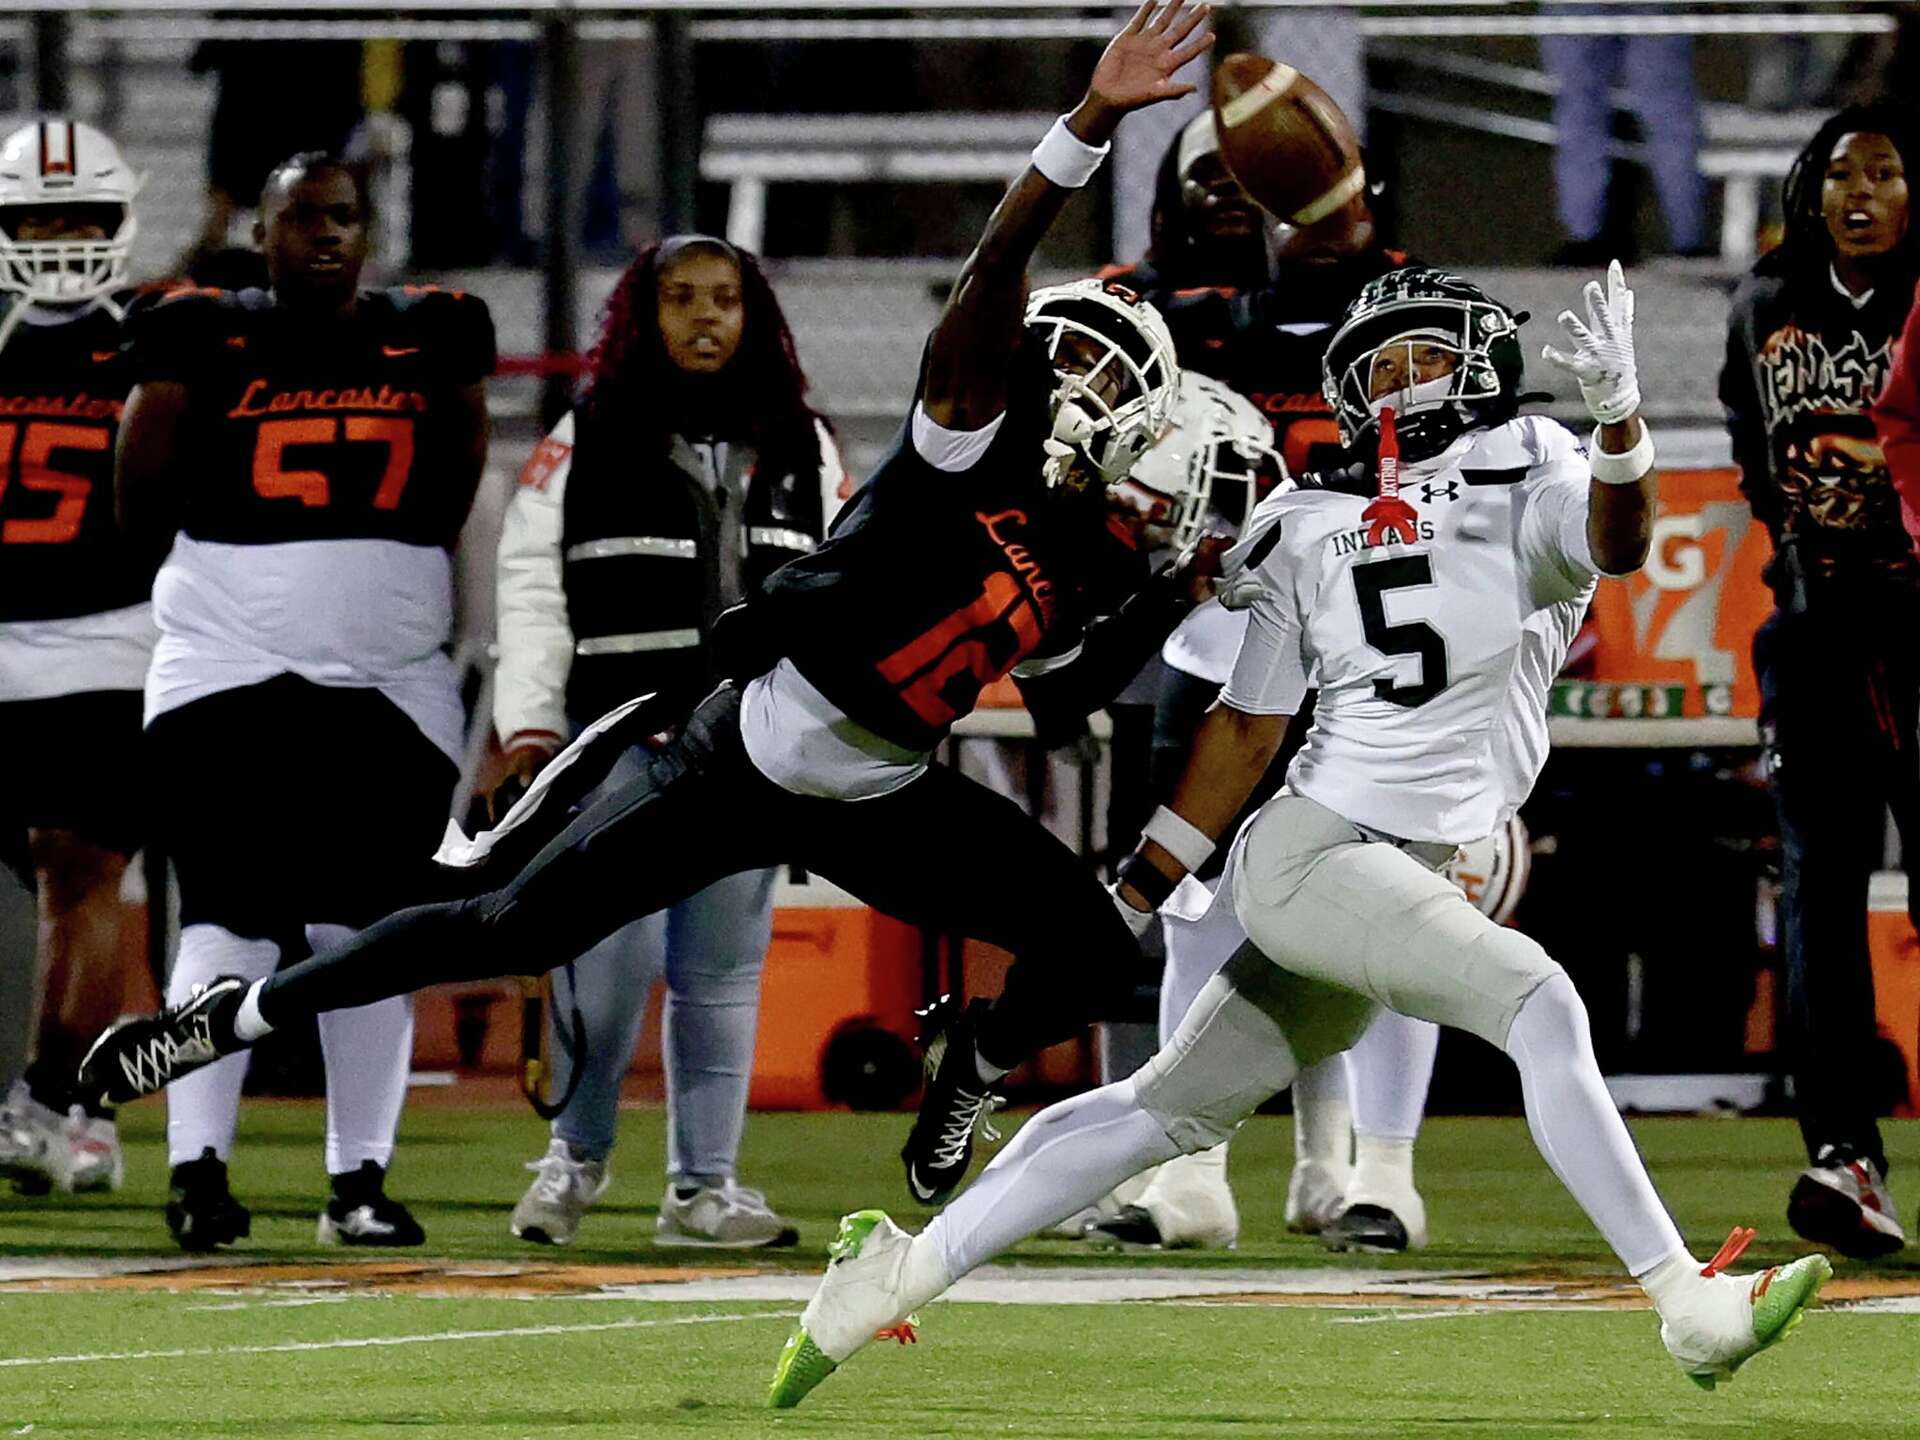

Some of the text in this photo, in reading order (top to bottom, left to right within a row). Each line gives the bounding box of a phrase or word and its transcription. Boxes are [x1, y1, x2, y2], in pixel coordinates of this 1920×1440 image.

[226, 378, 430, 419] Lancaster
[0, 422, 109, 544] 5
[252, 416, 415, 510] 57
[1332, 521, 1434, 557] INDAS
[1643, 513, 1706, 591] G
[875, 571, 1042, 728] 12
[1352, 553, 1448, 708] 5
